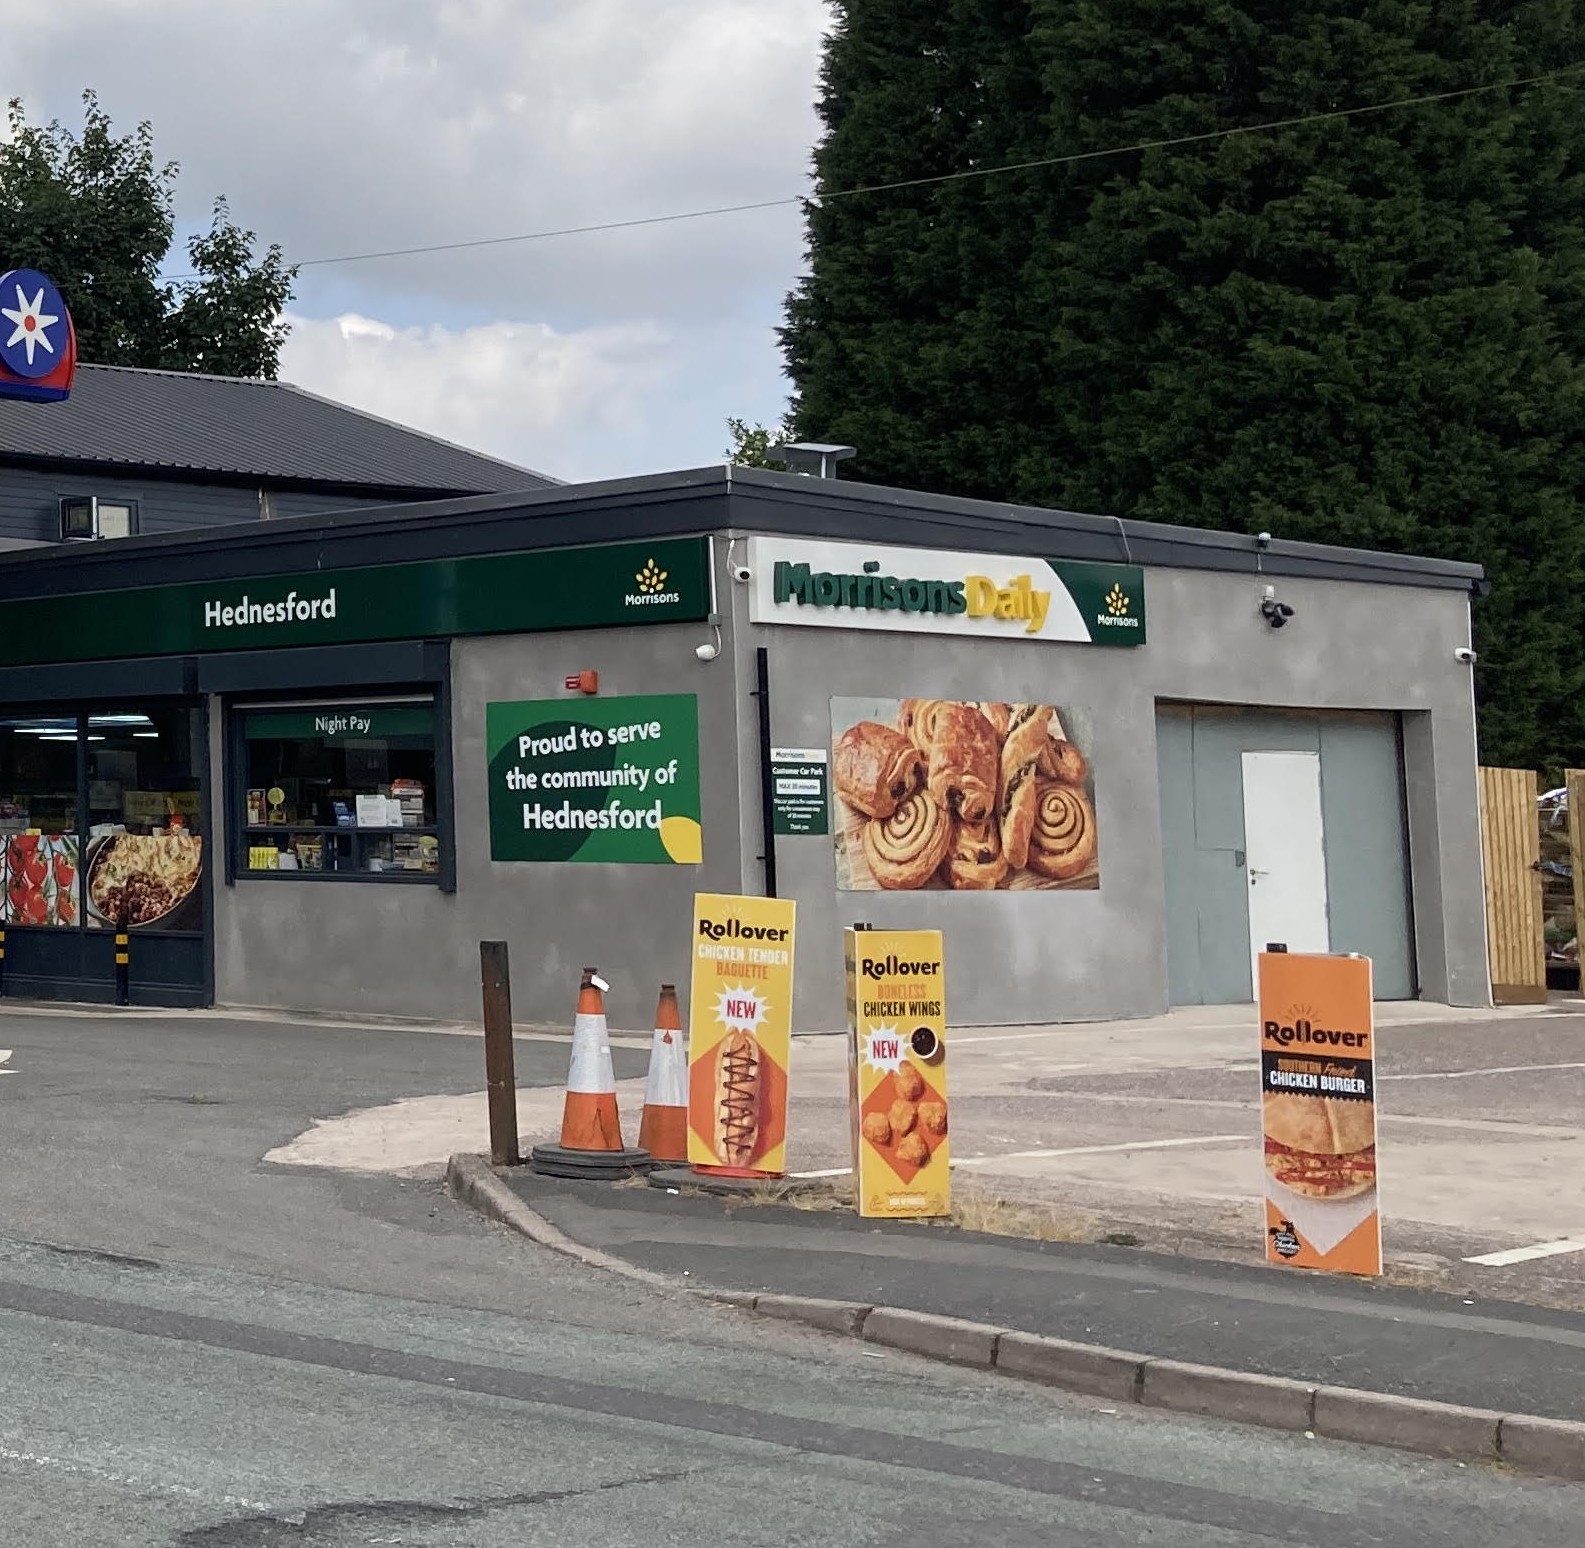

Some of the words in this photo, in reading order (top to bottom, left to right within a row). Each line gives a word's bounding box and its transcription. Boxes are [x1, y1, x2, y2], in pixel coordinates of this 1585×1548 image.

[205, 588, 336, 627] Hednesford
[625, 588, 680, 606] Morrisons
[773, 561, 966, 614] Morrisons
[966, 575, 1051, 633] Daily
[1097, 612, 1139, 627] Morrisons
[315, 716, 347, 735] Night
[350, 715, 371, 734] Pay
[518, 726, 577, 758] Proud
[579, 727, 604, 749] to
[607, 721, 661, 745] serve
[505, 766, 537, 790] the
[541, 763, 650, 792] community
[655, 759, 678, 784] of
[523, 799, 662, 830] Hednesford
[699, 918, 789, 942] Rollover
[698, 943, 744, 961] CHICKEN
[748, 947, 789, 965] TENDER
[716, 961, 769, 980] BAGUETTE
[862, 955, 940, 980] Rollover
[727, 999, 757, 1020] NEW
[863, 1001, 906, 1017] CHICKEN
[909, 1001, 941, 1017] WINGS
[1264, 1019, 1368, 1048] Rollover
[872, 1040, 899, 1059] NEW
[1269, 1070, 1318, 1089] CHICKEN
[1320, 1075, 1366, 1094] BURGER
